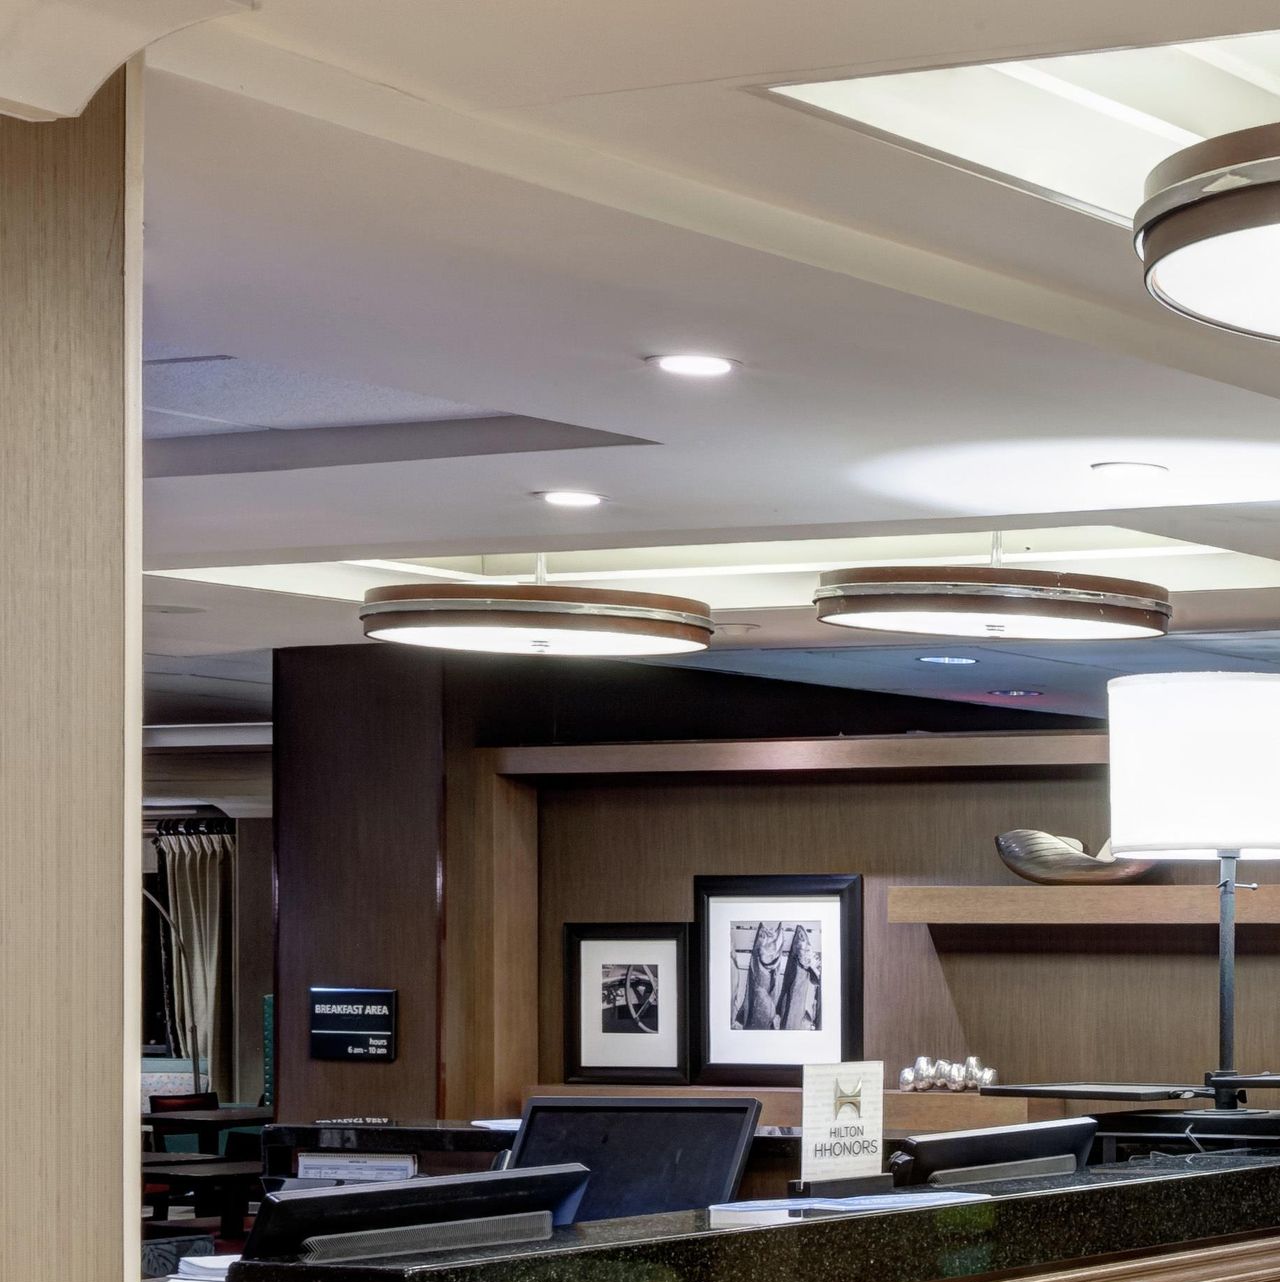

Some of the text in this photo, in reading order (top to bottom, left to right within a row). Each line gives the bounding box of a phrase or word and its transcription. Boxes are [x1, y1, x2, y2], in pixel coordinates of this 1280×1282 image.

[315, 1004, 389, 1015] BREAKFAST AREA
[369, 1037, 388, 1045] hours
[830, 1125, 865, 1138] HILTON
[814, 1139, 879, 1158] HHONORS
